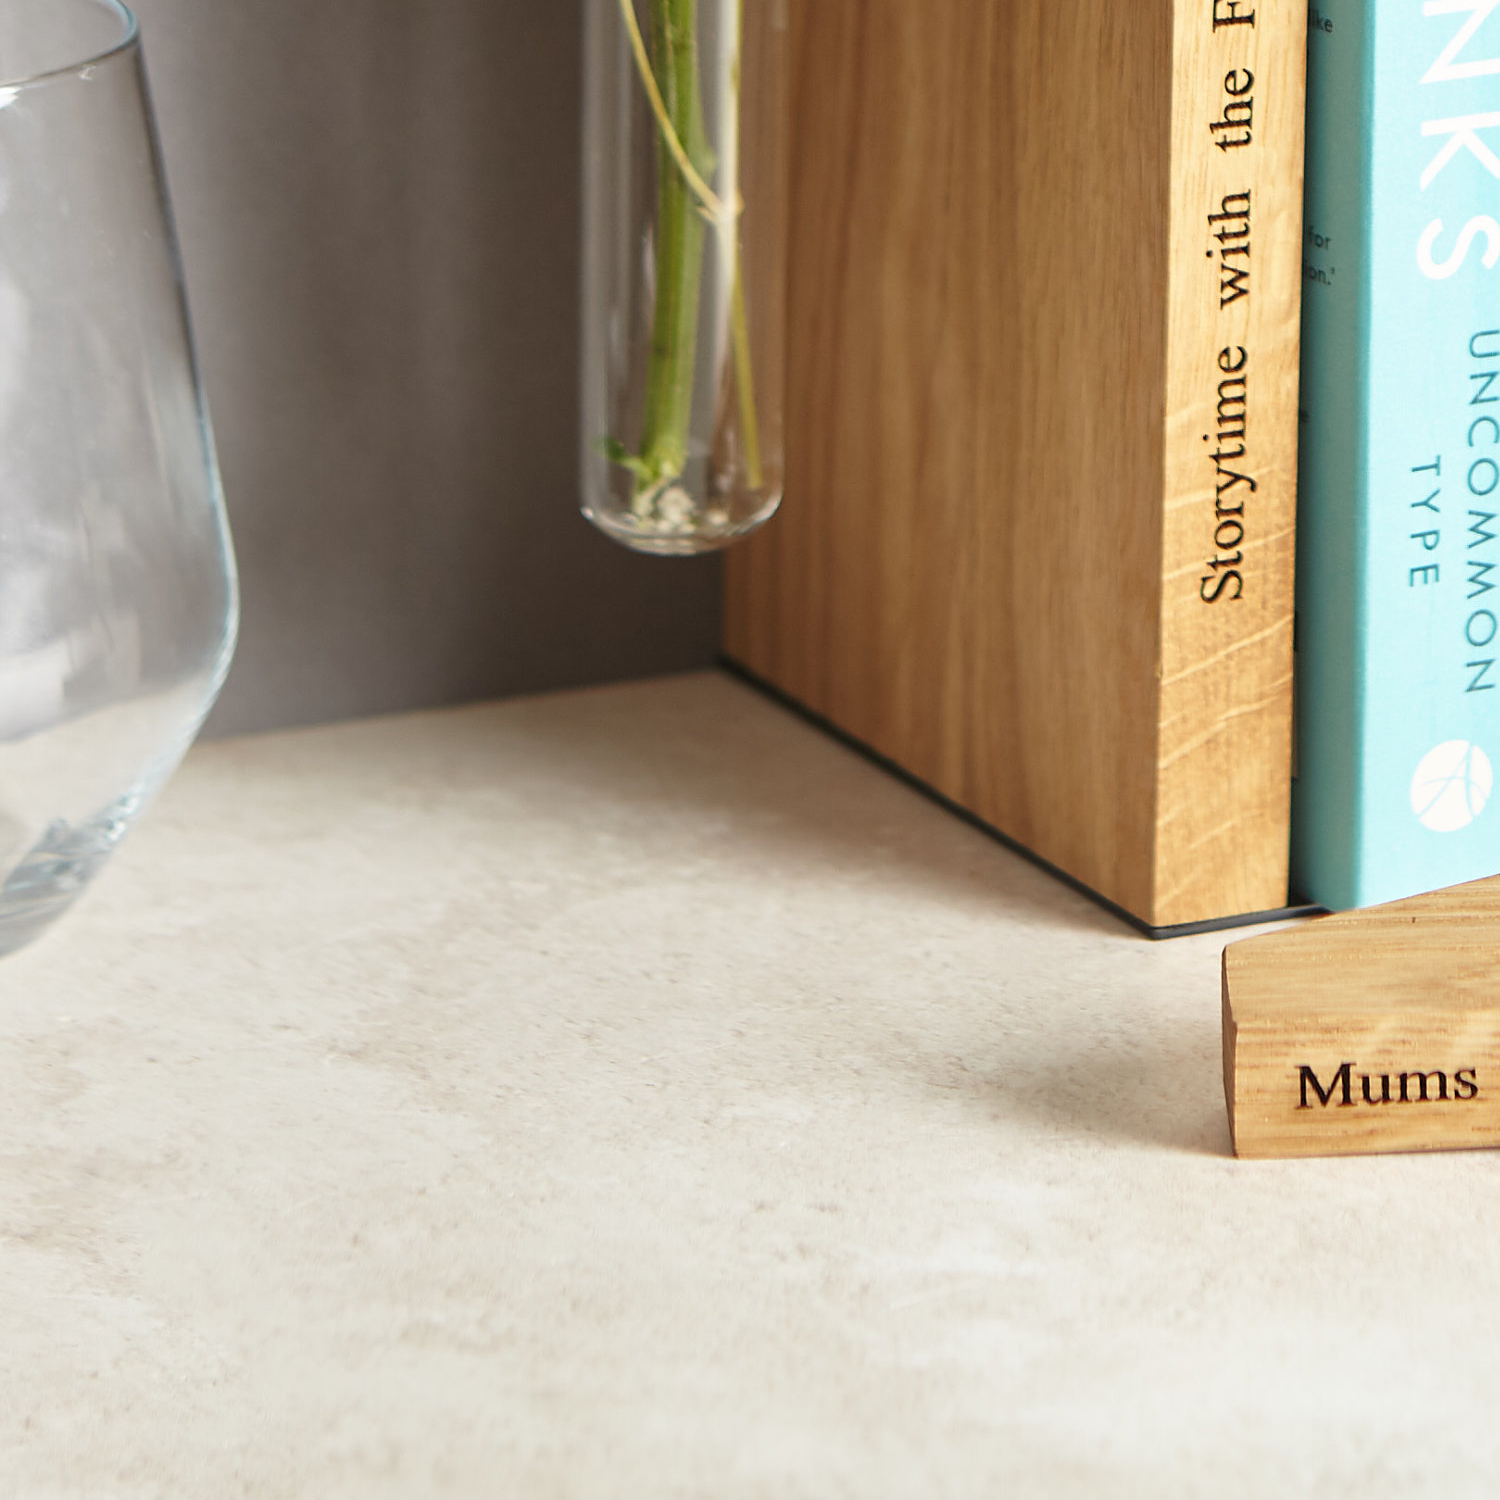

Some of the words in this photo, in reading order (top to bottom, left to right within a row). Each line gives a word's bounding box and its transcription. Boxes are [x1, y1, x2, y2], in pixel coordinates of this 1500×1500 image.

[1208, 66, 1255, 154] the
[1205, 187, 1252, 311] with
[1199, 344, 1258, 605] Storytime
[1409, 454, 1442, 589] TYPE
[1465, 329, 1500, 694] UNCOMMON
[1295, 1060, 1479, 1112] Mums
